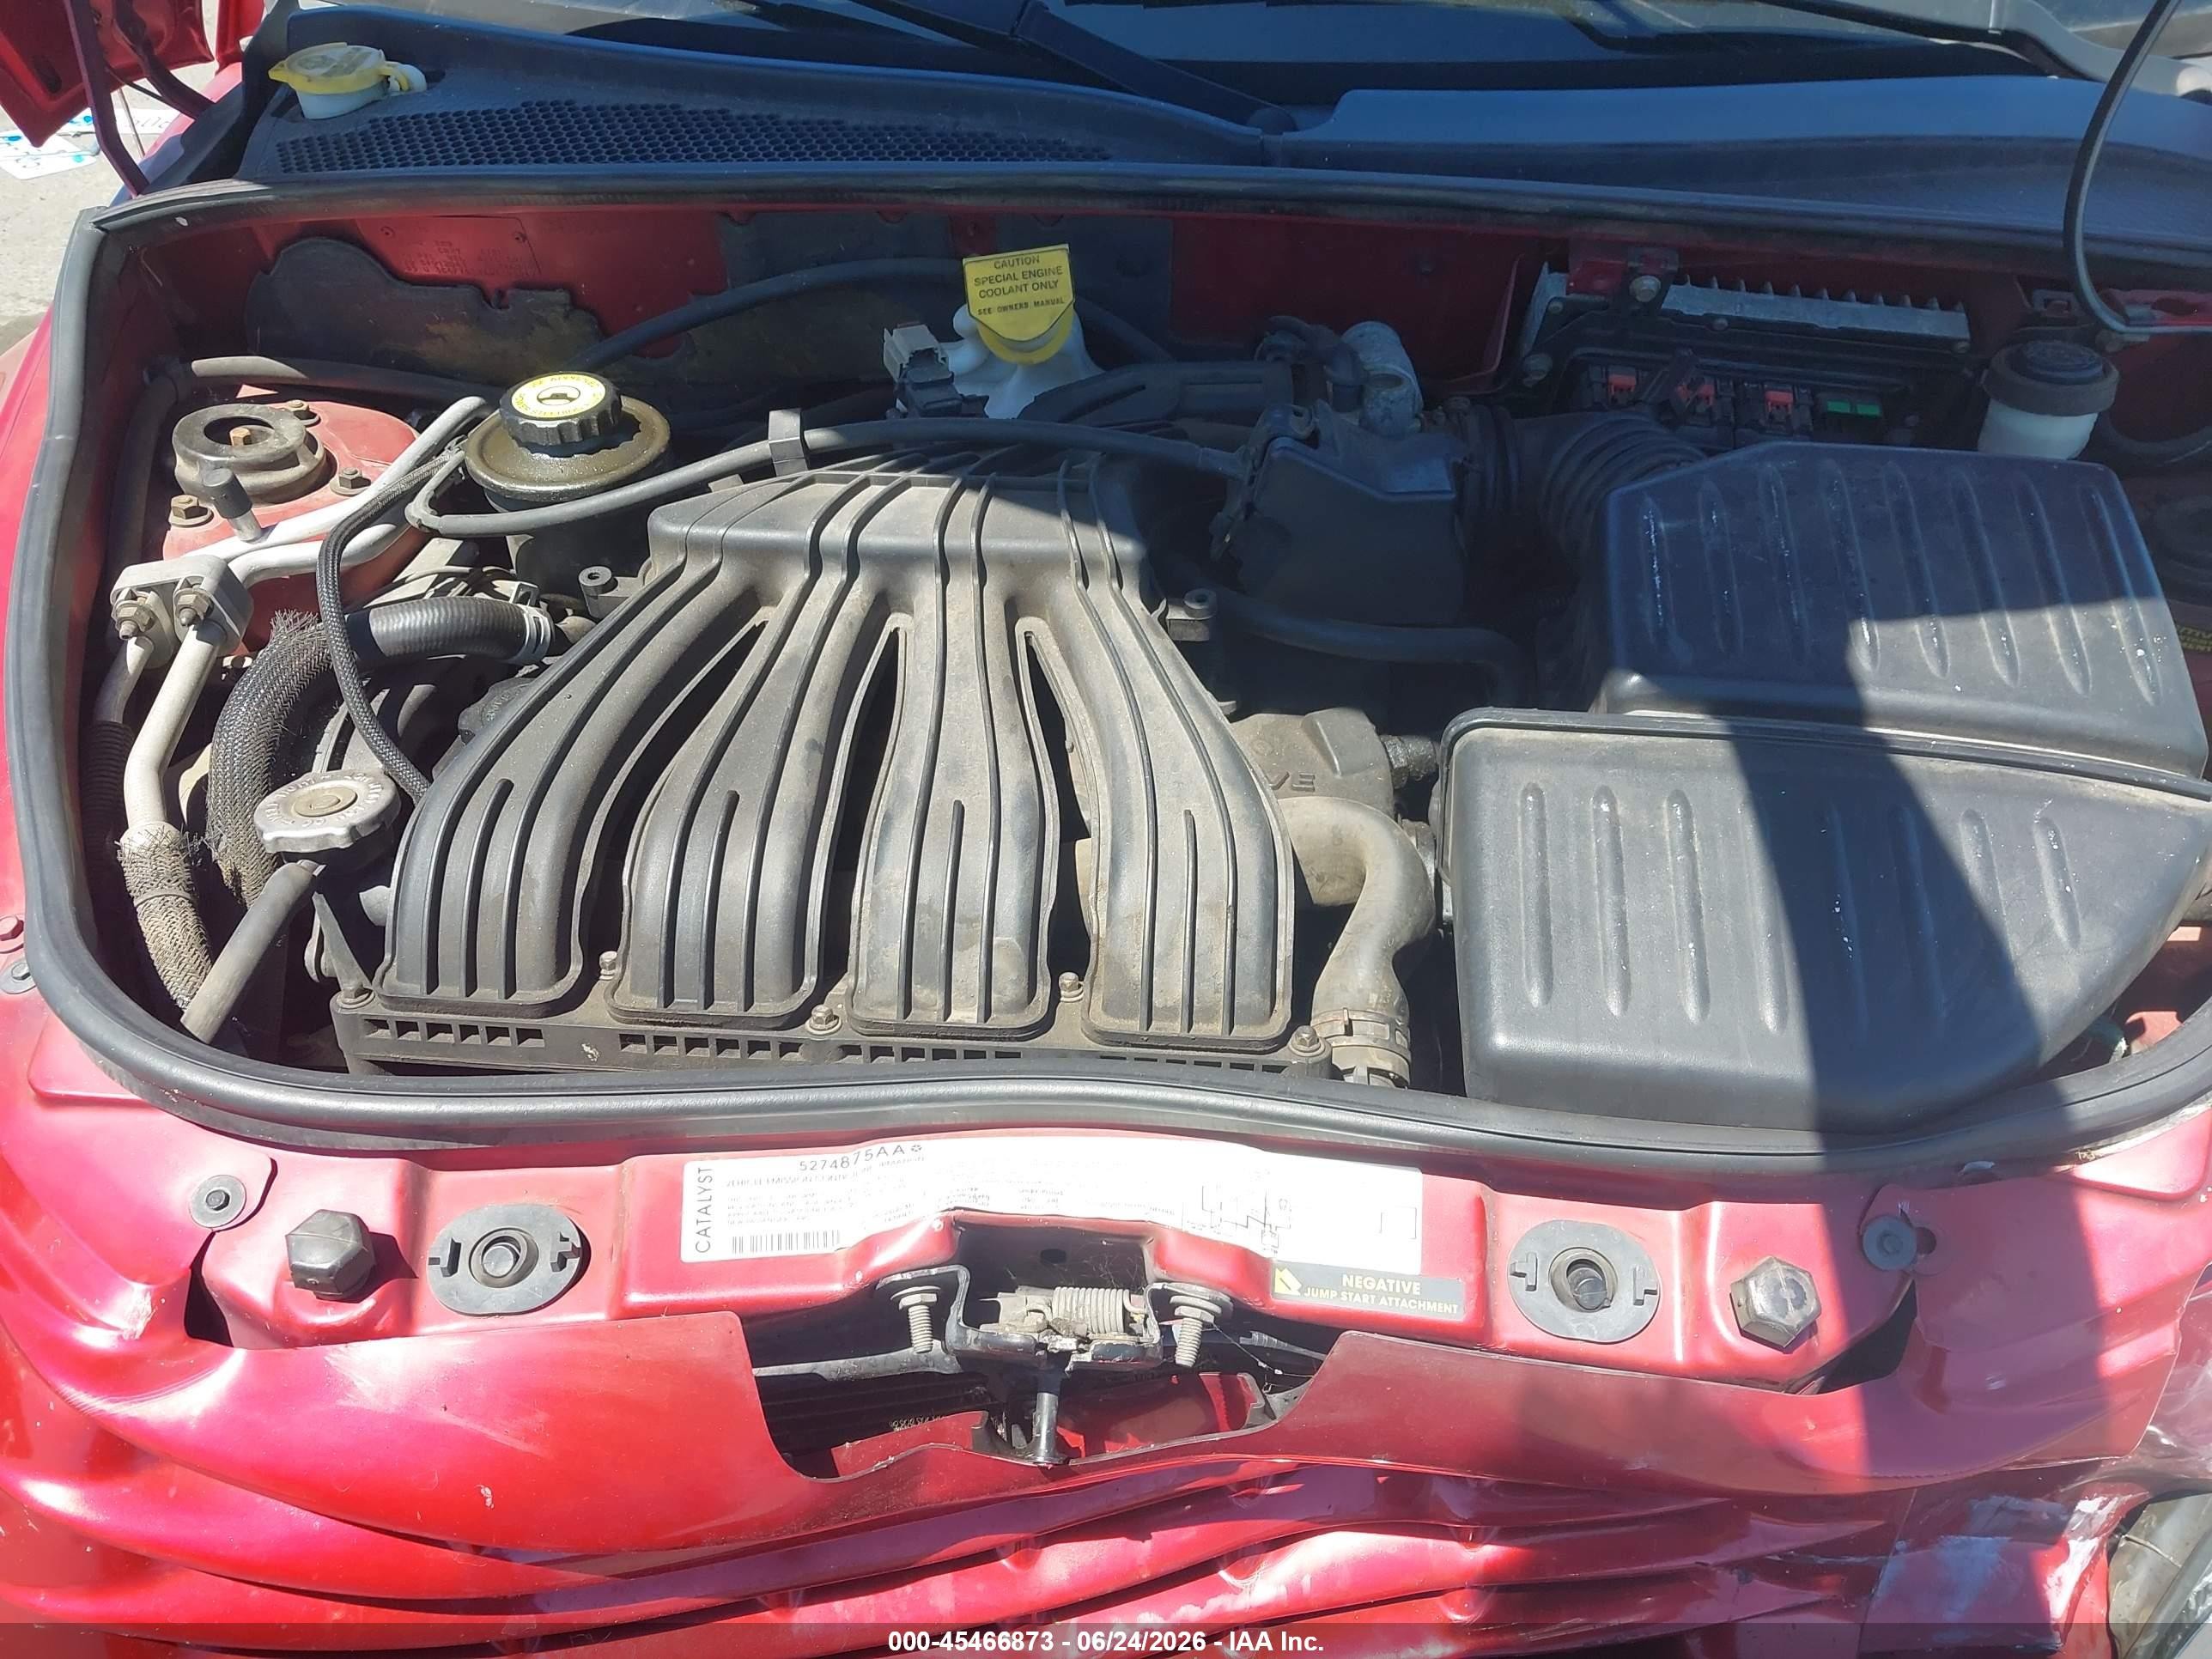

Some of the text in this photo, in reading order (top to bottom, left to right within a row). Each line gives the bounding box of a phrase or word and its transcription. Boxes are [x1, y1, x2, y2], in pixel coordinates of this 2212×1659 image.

[994, 255, 1040, 270] CAUTION
[974, 266, 1063, 287] SPECIAL ENGINE
[978, 279, 1060, 299] COOLANT ONLY
[1033, 298, 1065, 307] MANUAL
[799, 1145, 906, 1172] 5274875AA
[695, 1166, 715, 1254] CATALYST
[1342, 1274, 1421, 1295] NEGATIVE
[1304, 1286, 1459, 1314] JUMP START ATTACHMENT
